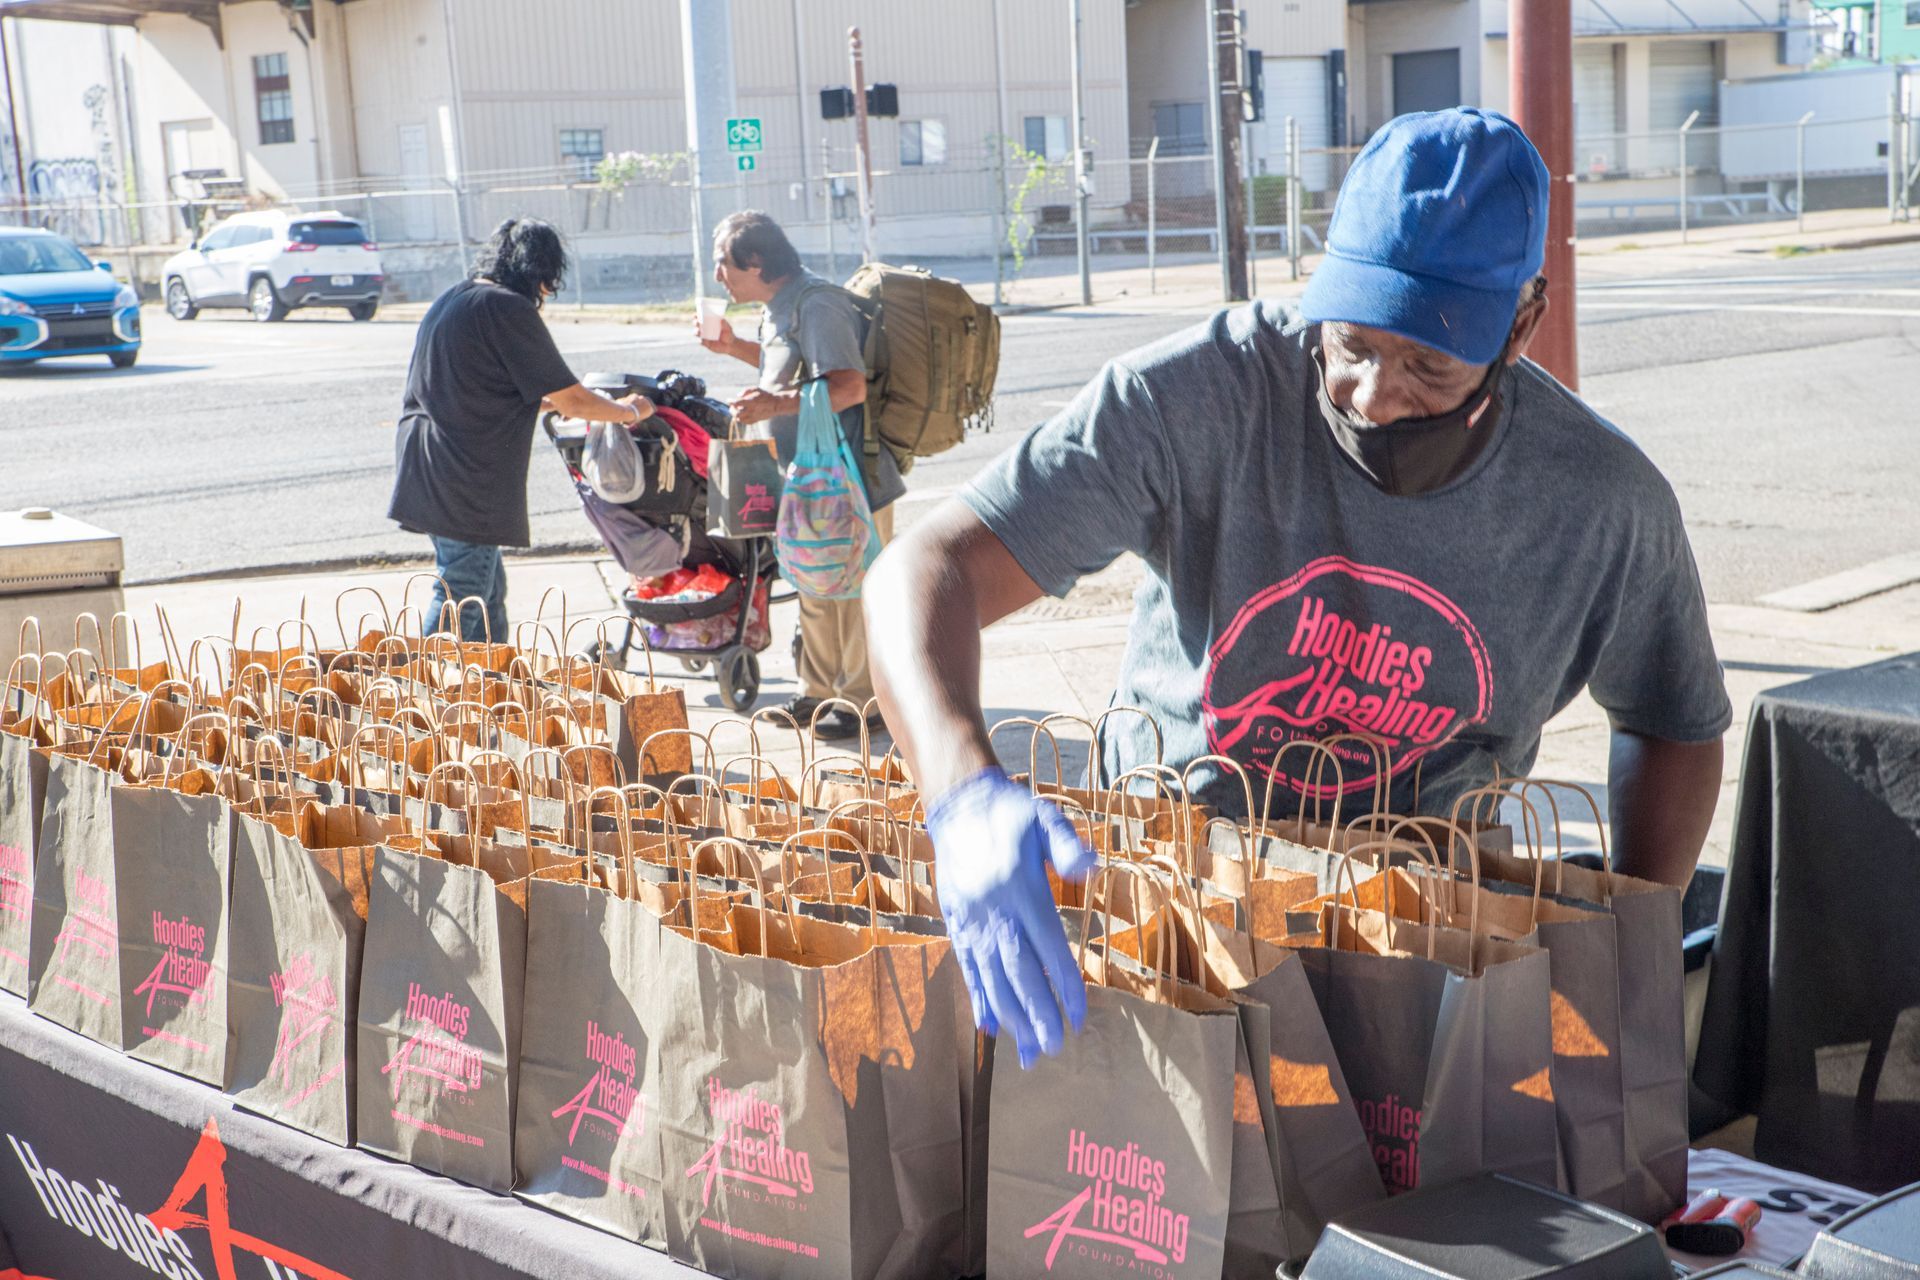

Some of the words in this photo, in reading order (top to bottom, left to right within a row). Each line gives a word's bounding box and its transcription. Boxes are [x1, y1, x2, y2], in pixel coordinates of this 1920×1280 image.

[1287, 596, 1433, 692] Hoodies
[1296, 659, 1457, 744] Healing
[153, 910, 205, 953] Hoodies
[406, 982, 470, 1037] Hoodies
[420, 1025, 483, 1090] Healing
[586, 1020, 636, 1078] Hoodies
[598, 1065, 646, 1136] Healing
[709, 1075, 784, 1135] Hoodies
[729, 1122, 815, 1195] Healing
[1067, 1128, 1167, 1197] Hoodies
[6, 1132, 204, 1280] Hoodies
[1092, 1178, 1190, 1264] Healing
